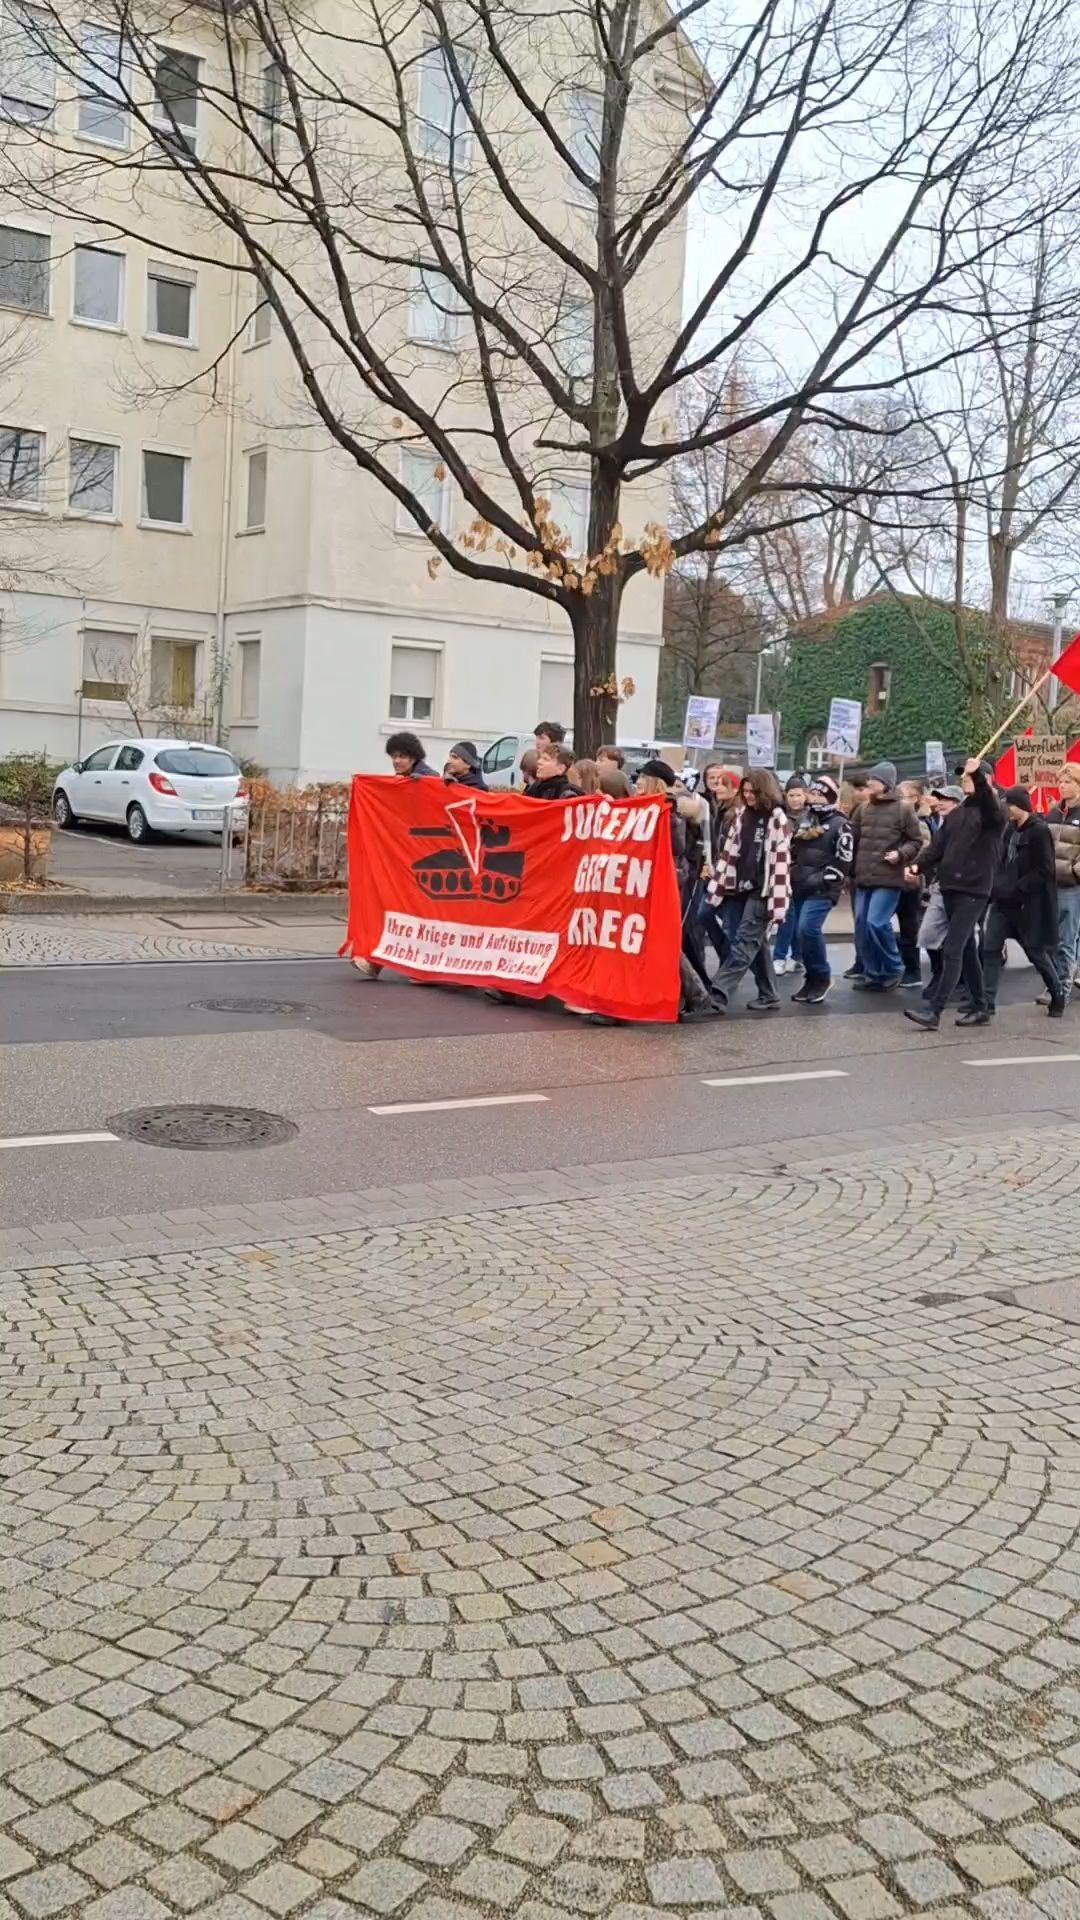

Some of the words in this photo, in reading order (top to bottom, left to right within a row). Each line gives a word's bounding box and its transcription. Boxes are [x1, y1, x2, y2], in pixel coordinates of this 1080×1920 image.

[1015, 738, 1064, 754] Wehrpflicht
[561, 801, 661, 842] JUGEND
[387, 917, 413, 939] Ihre
[417, 924, 456, 948] Kriege
[461, 932, 484, 950] und
[486, 933, 553, 958] Aufrüstung
[384, 943, 420, 963] nicht
[423, 951, 444, 967] auf
[445, 955, 493, 972] unserem
